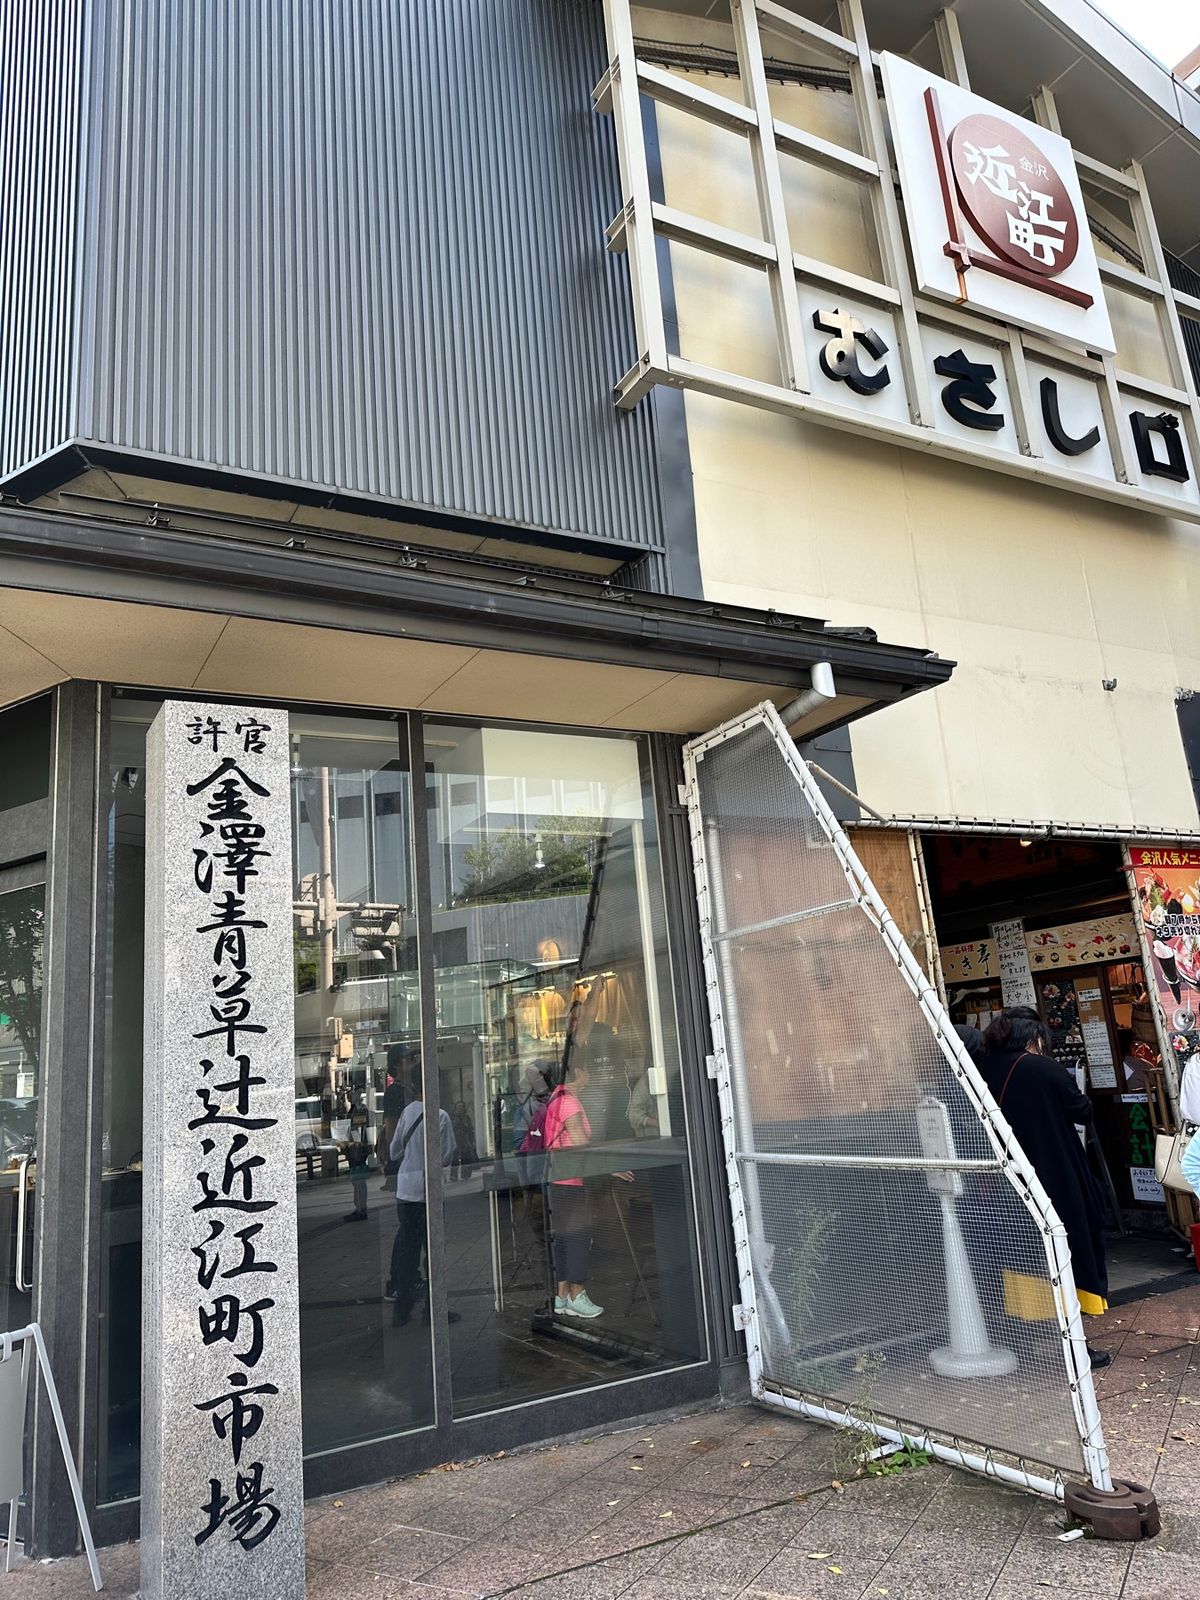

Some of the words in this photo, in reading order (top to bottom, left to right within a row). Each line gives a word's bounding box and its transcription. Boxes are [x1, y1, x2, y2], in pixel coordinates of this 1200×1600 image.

[963, 141, 1068, 267] 近江町
[1017, 156, 1050, 181] 金沢
[812, 307, 1190, 484] むさし口
[1141, 851, 1200, 866] 金沢人気メニ
[186, 757, 279, 1552] 金澤青草辻近江町市場
